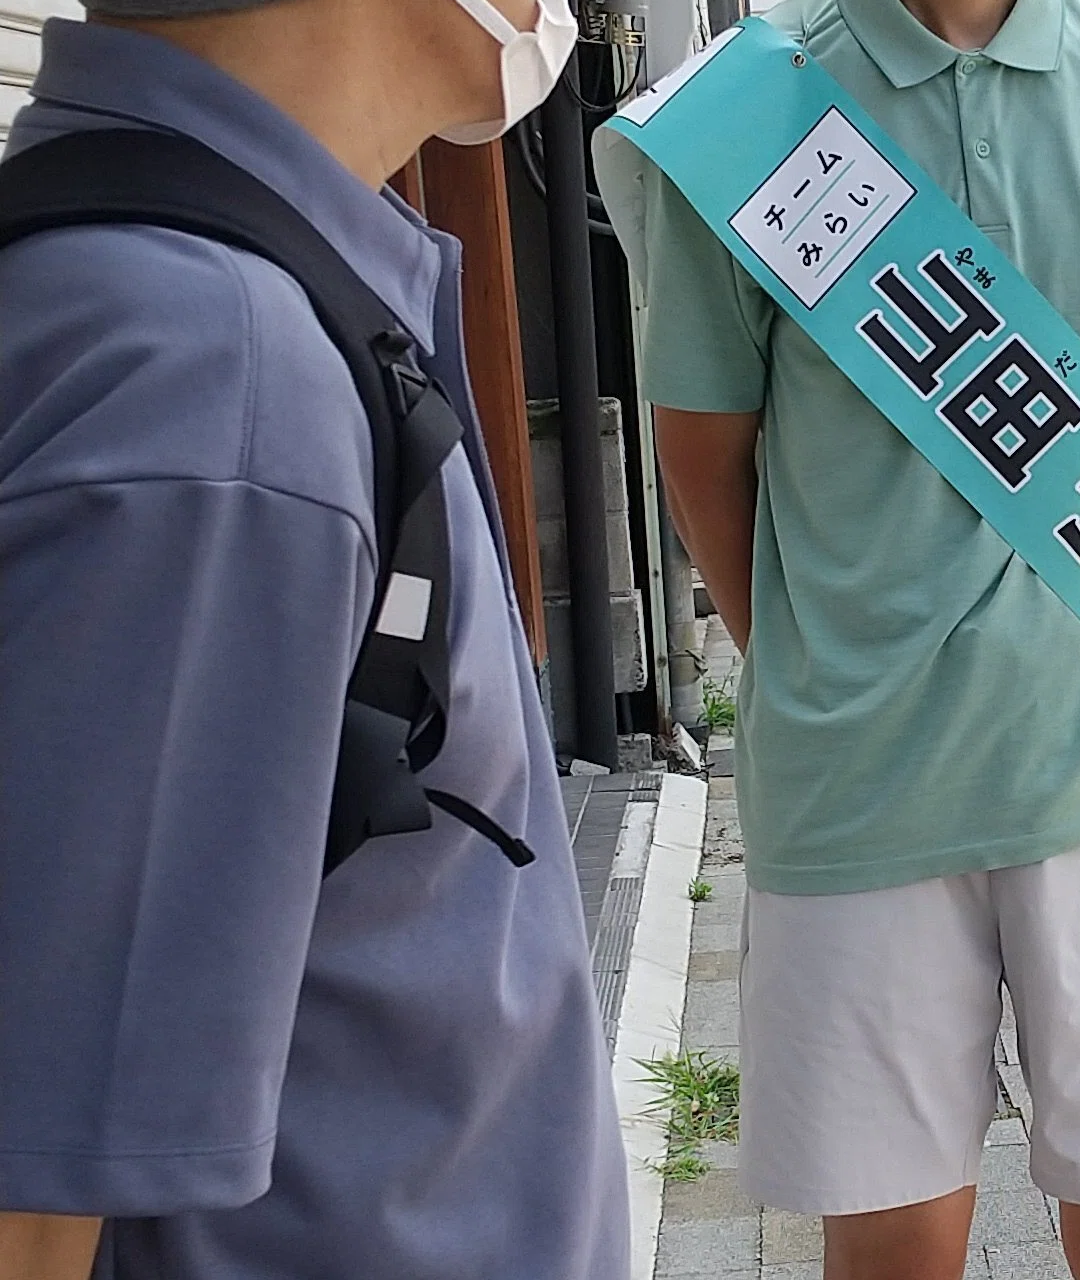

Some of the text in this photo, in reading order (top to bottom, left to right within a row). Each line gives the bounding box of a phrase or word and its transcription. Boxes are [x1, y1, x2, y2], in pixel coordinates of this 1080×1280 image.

[762, 149, 843, 232] チーム
[797, 183, 876, 268] みらい
[953, 246, 997, 290] やま
[1054, 349, 1078, 379] だ
